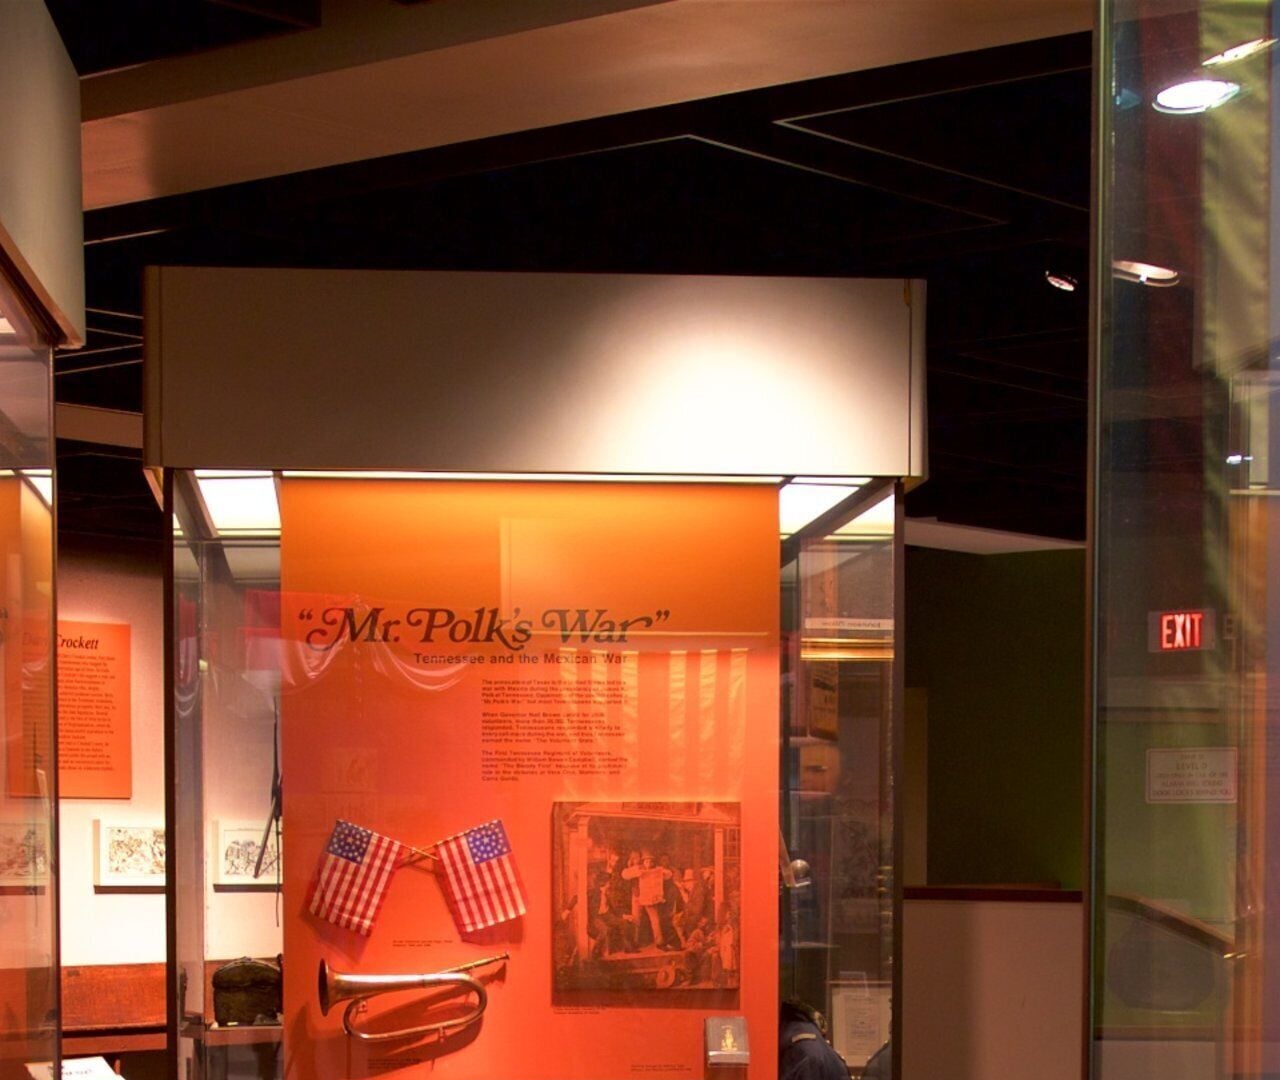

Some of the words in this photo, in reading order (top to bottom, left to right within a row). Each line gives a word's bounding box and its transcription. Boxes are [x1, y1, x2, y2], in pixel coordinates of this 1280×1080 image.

[1162, 613, 1202, 649] EXIT
[414, 652, 485, 664] Tennessee
[490, 653, 514, 665] and
[518, 653, 539, 665] the
[544, 654, 597, 665] Mexican
[602, 654, 628, 665] War
